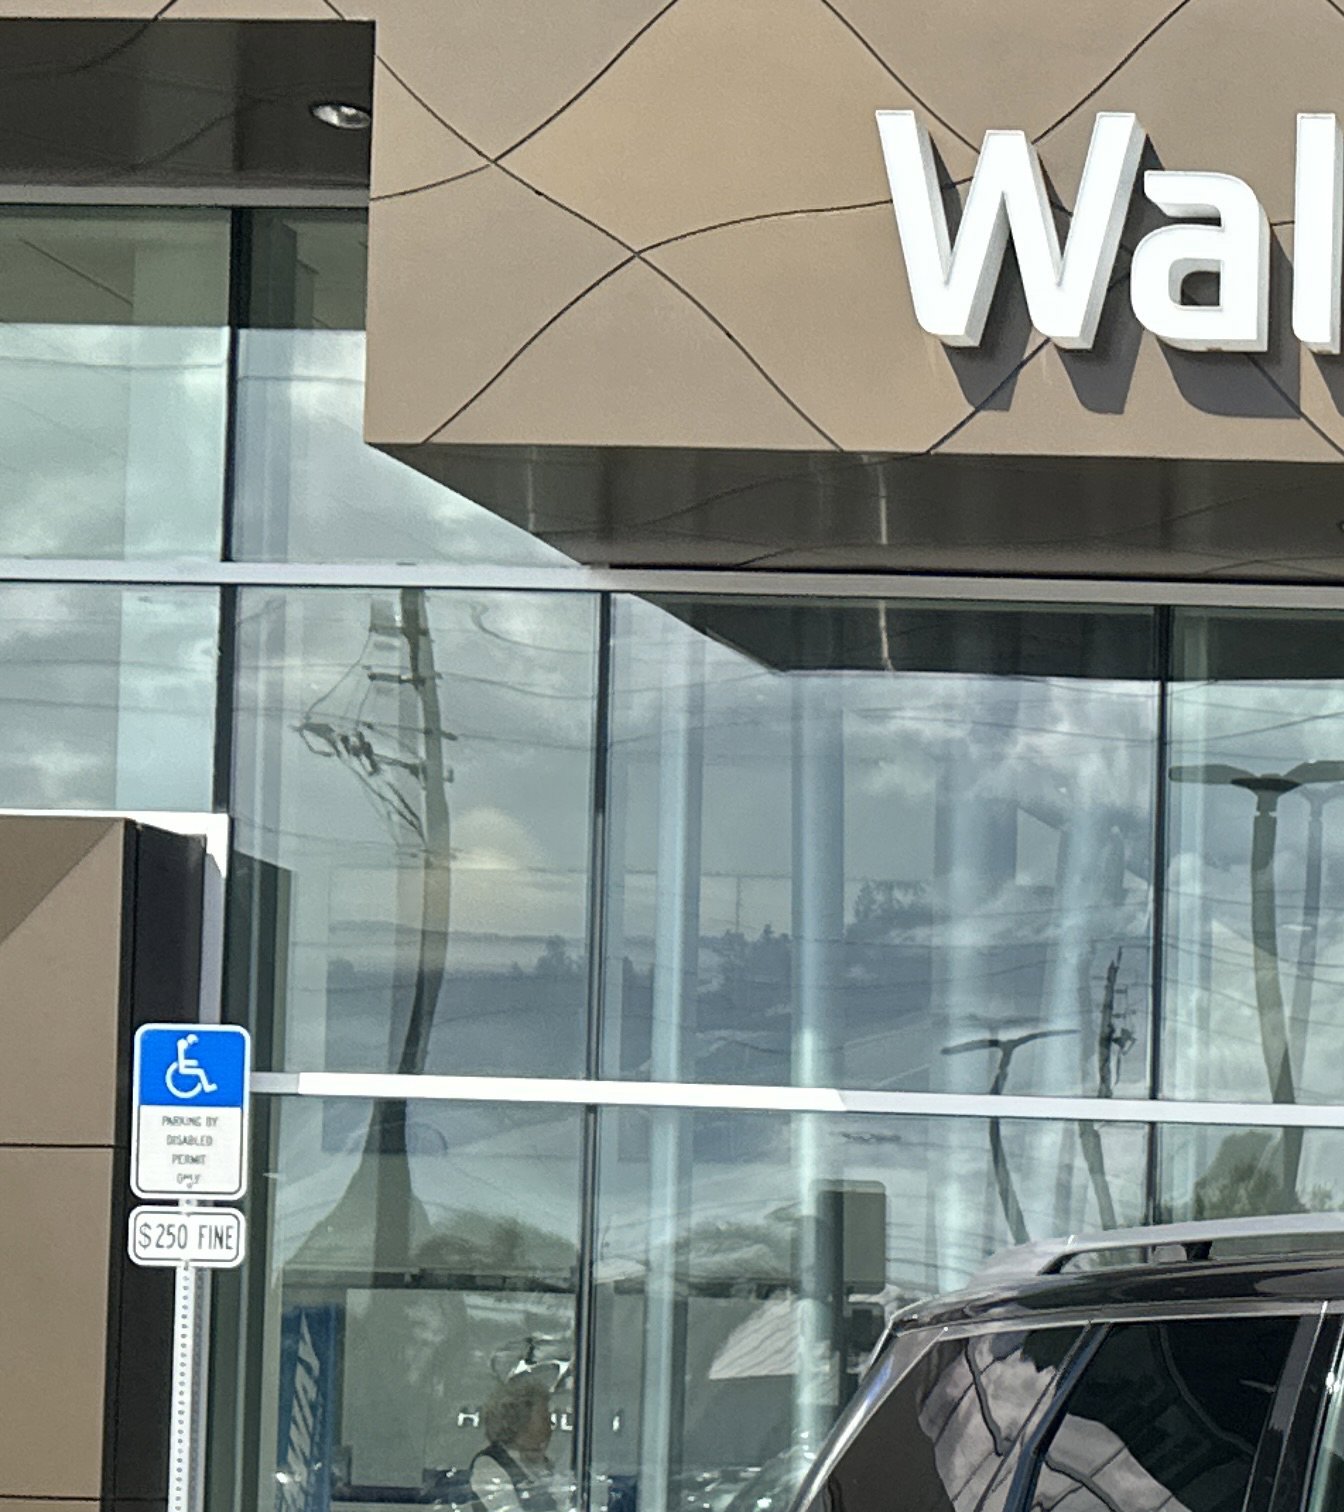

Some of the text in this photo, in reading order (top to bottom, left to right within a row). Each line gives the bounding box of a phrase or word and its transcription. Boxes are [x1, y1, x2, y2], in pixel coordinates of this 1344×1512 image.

[161, 1115, 219, 1128] PARKING BY
[166, 1134, 213, 1147] DISABLED
[172, 1153, 206, 1166] PERMIT
[138, 1222, 234, 1251] $250 FINE
